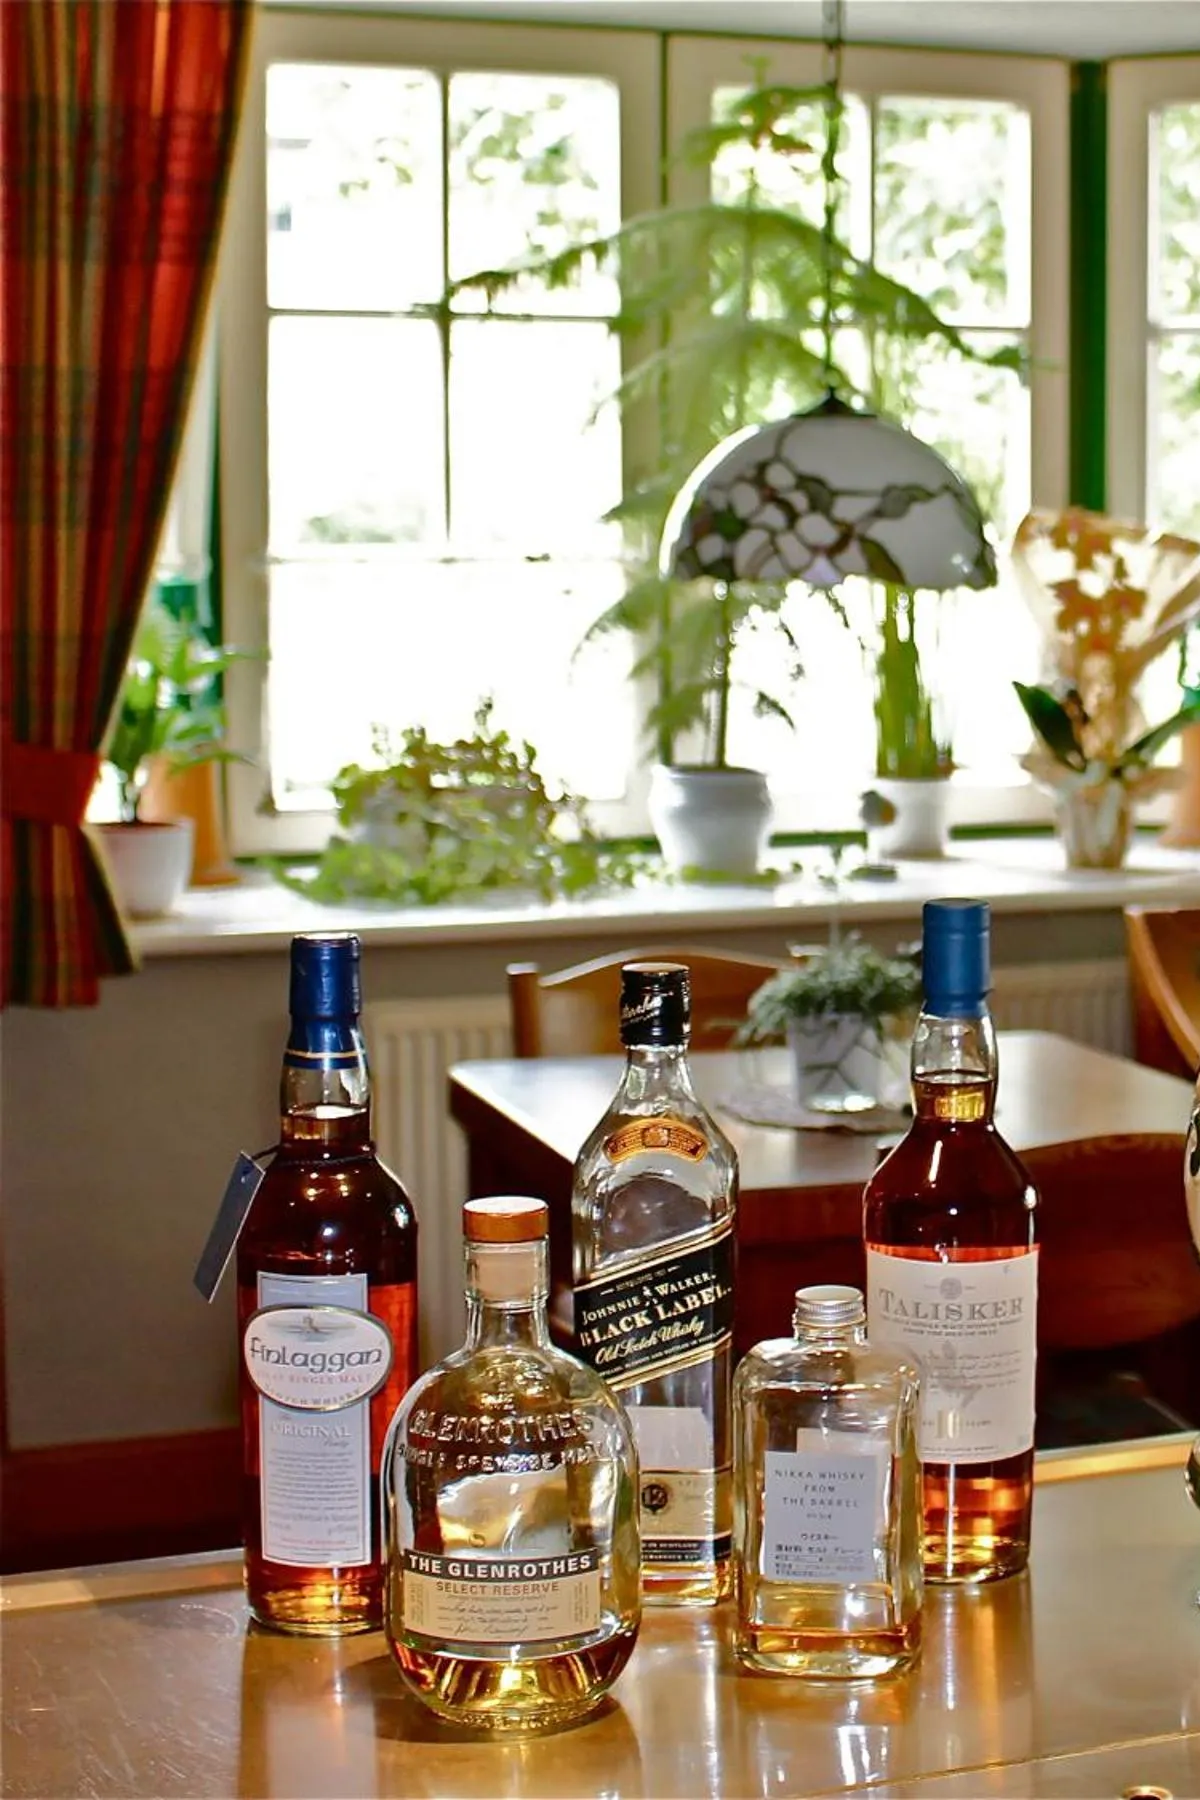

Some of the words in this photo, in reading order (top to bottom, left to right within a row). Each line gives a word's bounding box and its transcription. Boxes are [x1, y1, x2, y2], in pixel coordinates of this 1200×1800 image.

[582, 1295, 641, 1325] JOHNNIE
[878, 1288, 1025, 1321] TALISKER
[579, 1309, 653, 1347] BLACK
[594, 1346, 621, 1365] Old
[656, 1315, 705, 1340] Whisky
[249, 1336, 383, 1374] Finlaggan
[408, 1408, 594, 1445] GLENROTHES
[774, 1469, 814, 1479] NIKKA
[818, 1471, 865, 1481] WHISKY
[803, 1485, 836, 1493] FROM
[782, 1496, 806, 1506] THE
[810, 1498, 859, 1508] BARREL
[408, 1554, 441, 1574] THE
[447, 1555, 591, 1579] GLENROTHES
[435, 1580, 487, 1595] SELECT
[493, 1581, 560, 1596] RESERVE
